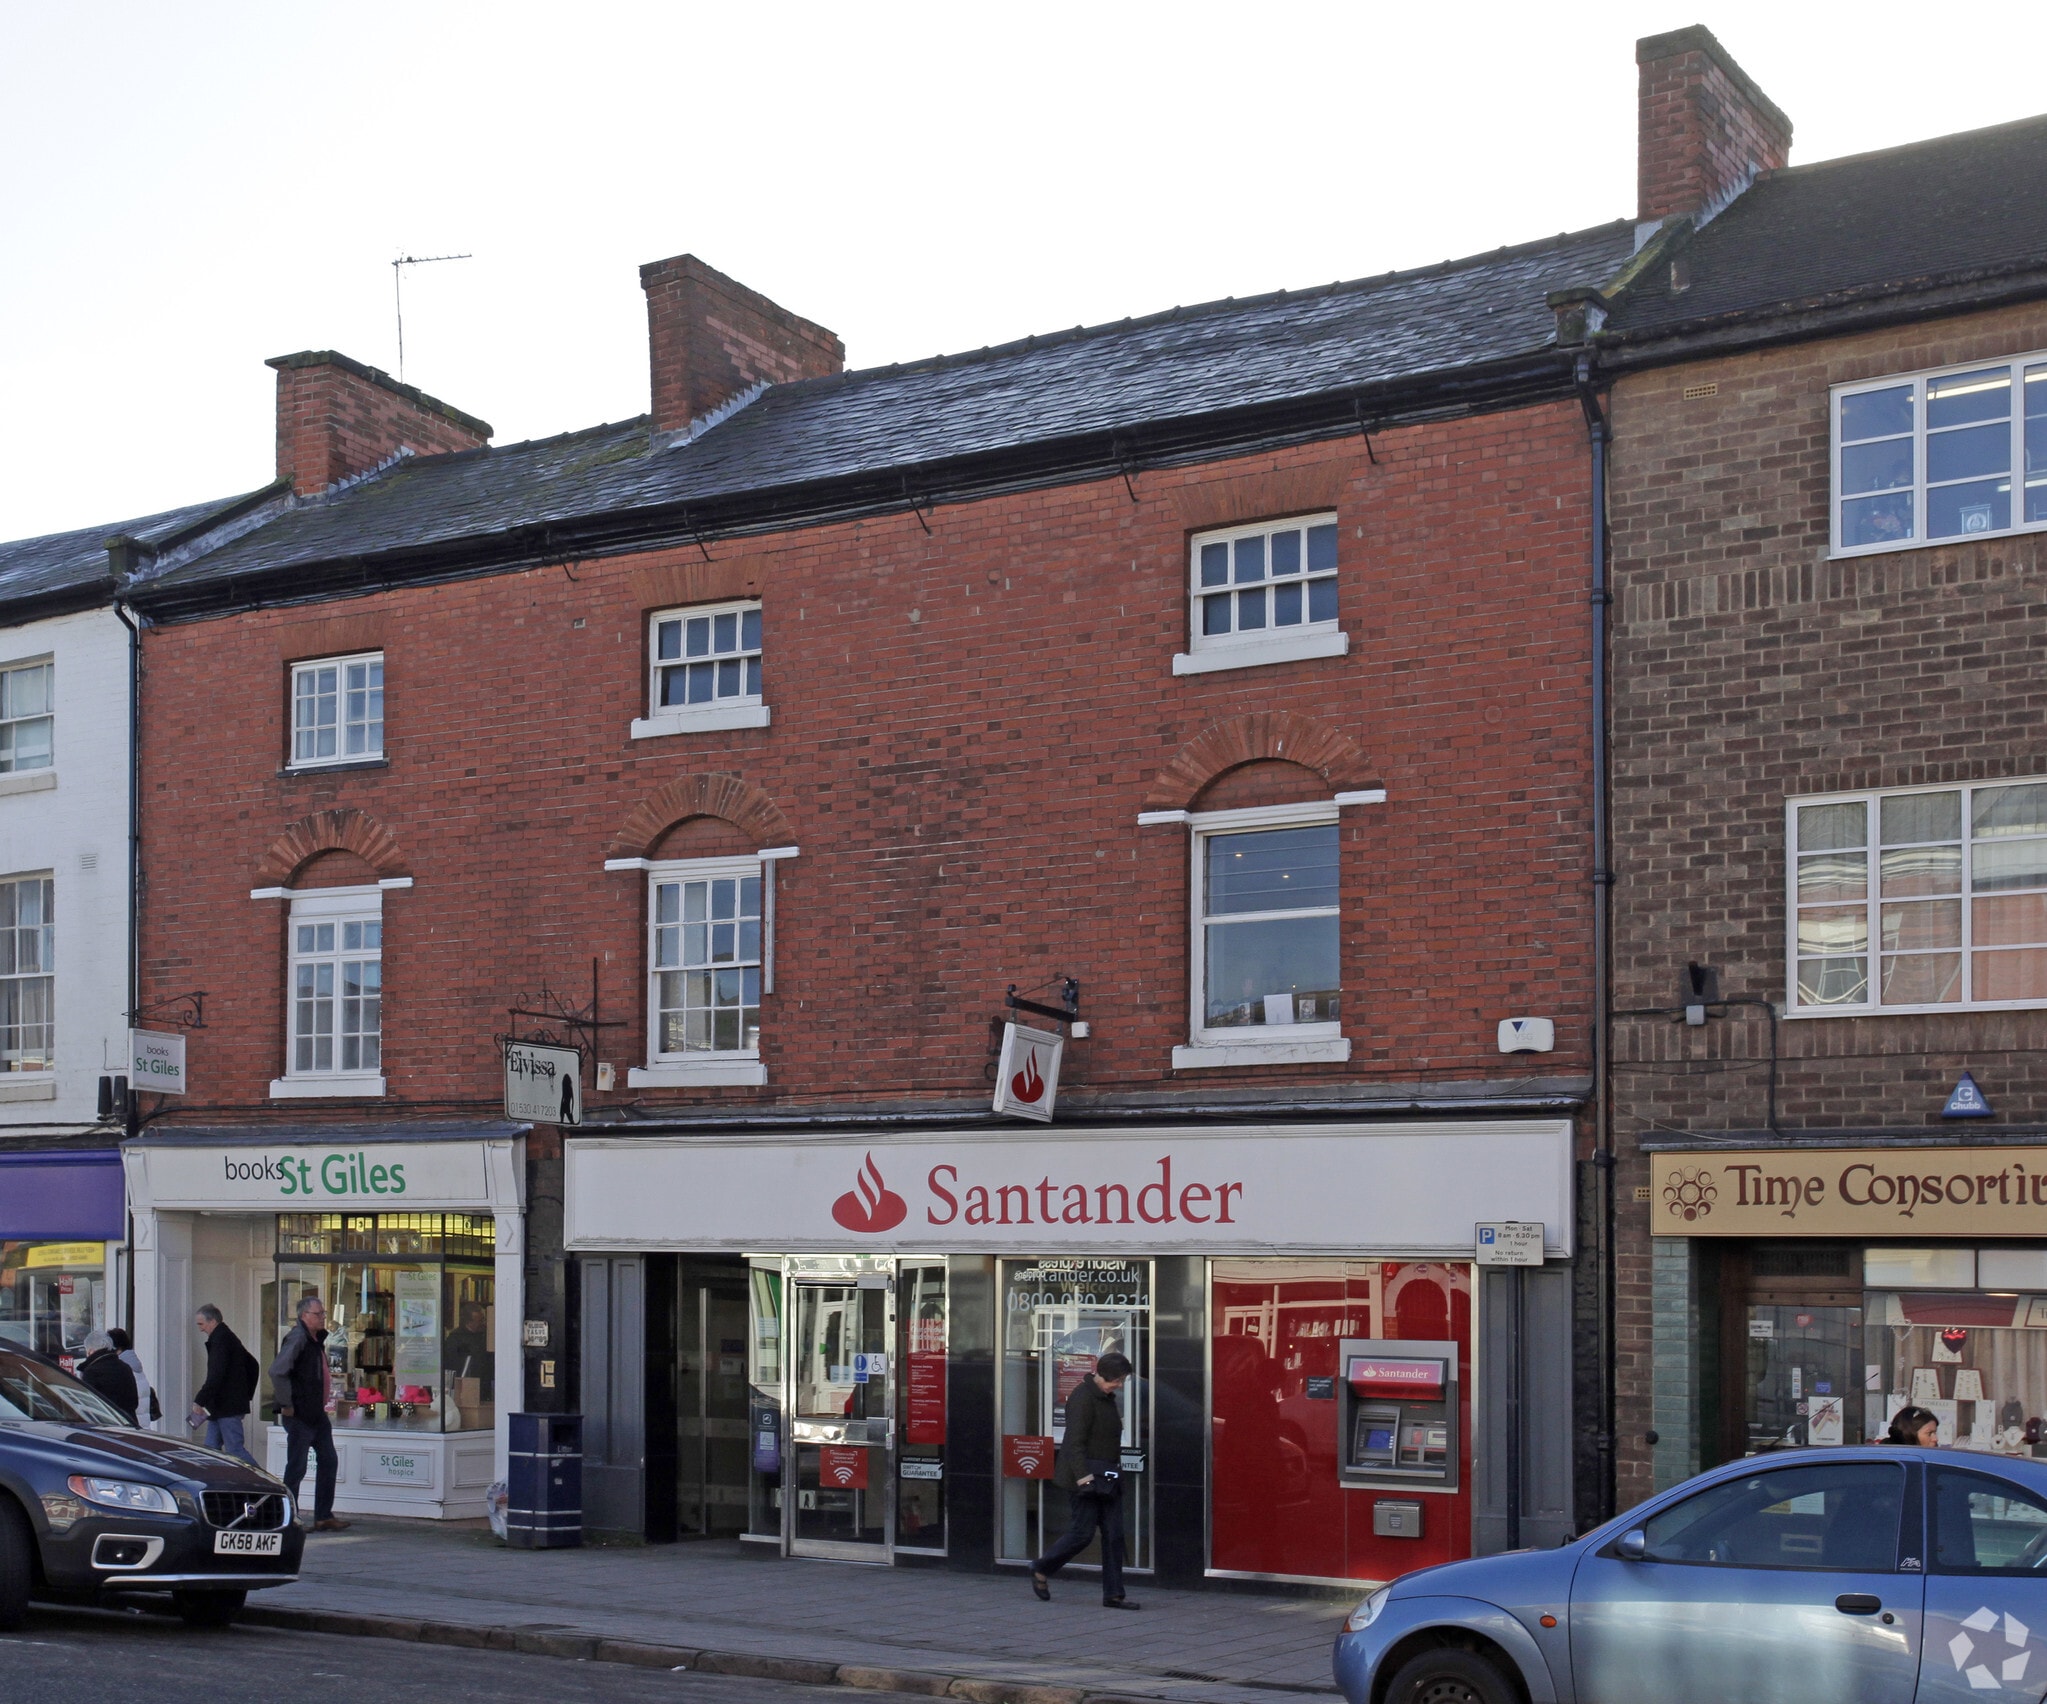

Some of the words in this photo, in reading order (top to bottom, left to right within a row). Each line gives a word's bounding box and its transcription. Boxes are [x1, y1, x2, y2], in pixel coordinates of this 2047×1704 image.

[146, 1044, 169, 1057] books
[136, 1057, 148, 1072] St
[150, 1059, 180, 1076] Giles
[511, 1102, 532, 1115] 01530
[532, 1104, 557, 1117] 417203
[1950, 1102, 1981, 1110] Chubb
[224, 1155, 285, 1181] books
[280, 1155, 314, 1195] St
[320, 1152, 406, 1195] Giles
[927, 1154, 1243, 1226] Santander
[1724, 1164, 1825, 1219] Time
[59, 1358, 73, 1368] Half
[1378, 1367, 1429, 1379] Santander
[381, 1455, 390, 1466] St
[392, 1456, 414, 1467] Giles
[388, 1468, 414, 1477] hospice
[220, 1533, 253, 1550] GK58
[255, 1535, 278, 1551] AKF
